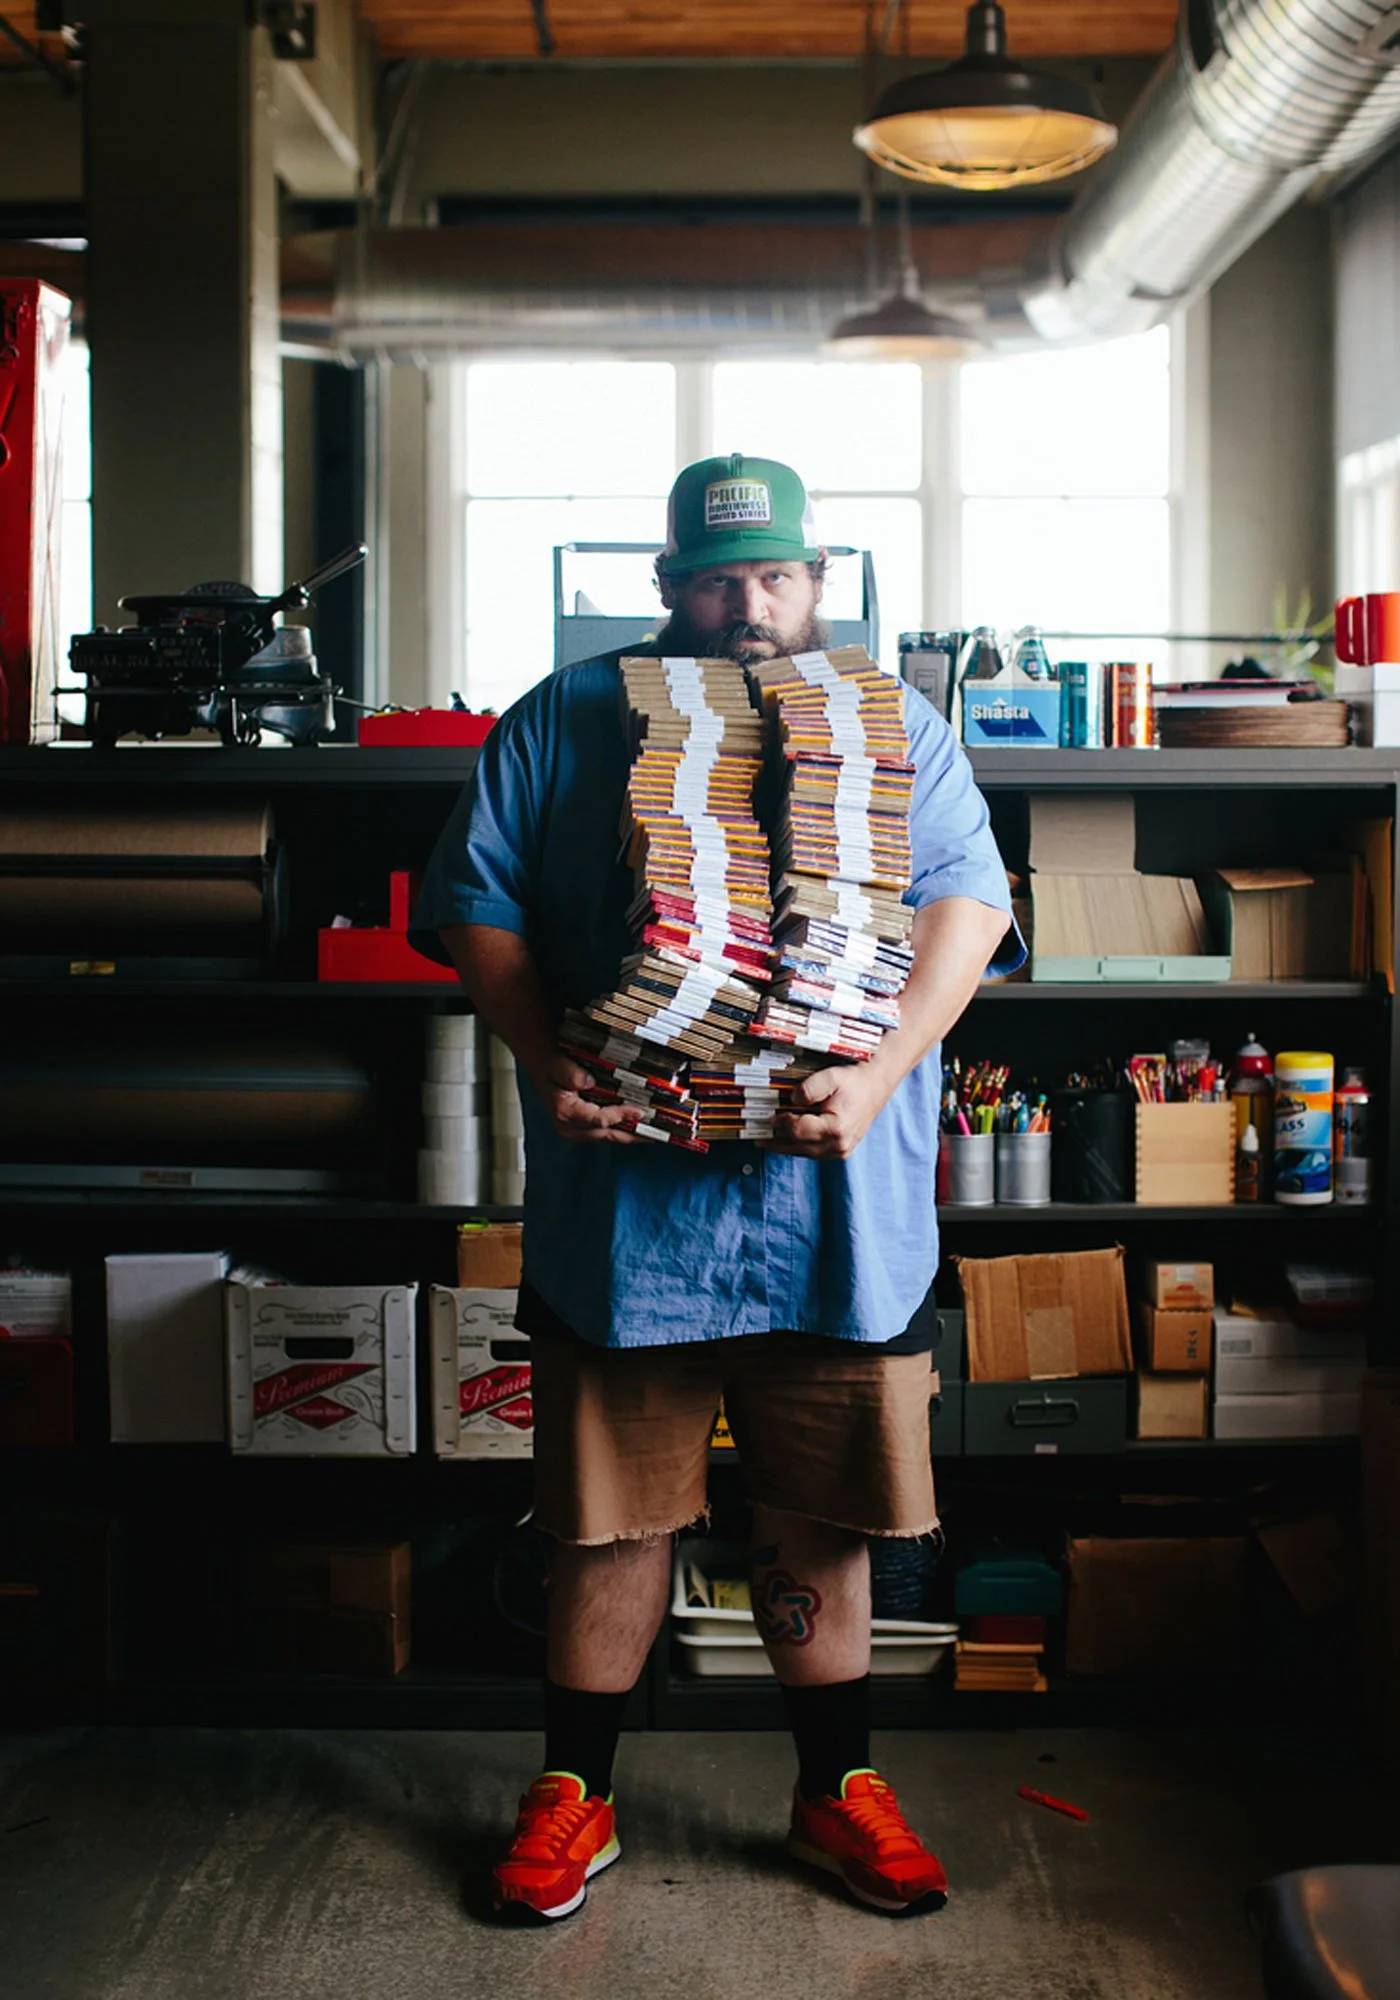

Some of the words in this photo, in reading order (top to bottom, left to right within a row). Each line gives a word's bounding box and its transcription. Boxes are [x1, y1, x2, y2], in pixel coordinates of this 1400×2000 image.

[738, 510, 767, 519] STATES
[971, 703, 1030, 720] Shasta
[256, 1366, 343, 1411] Premium
[460, 1375, 532, 1411] Premiu
[500, 1407, 528, 1418] Grain
